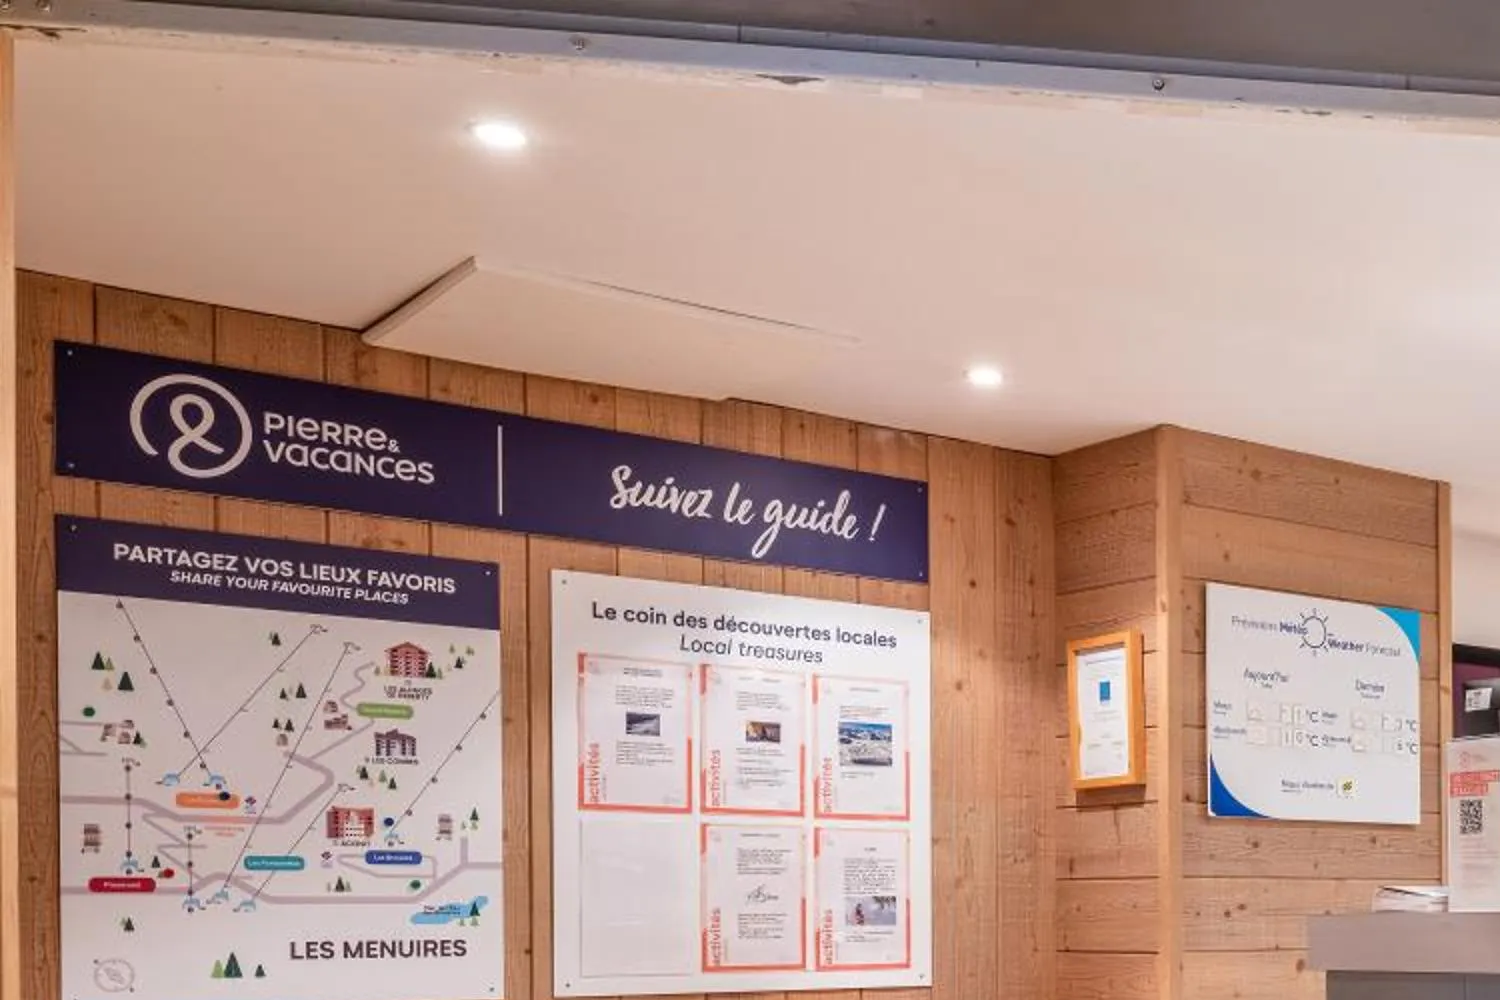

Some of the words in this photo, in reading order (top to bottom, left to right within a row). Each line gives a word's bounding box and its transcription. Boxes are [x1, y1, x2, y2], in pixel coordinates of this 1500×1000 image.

[610, 465, 713, 519] Suivez
[723, 482, 753, 525] le
[752, 490, 860, 558] guide
[113, 543, 239, 573] PARTAGEZ
[244, 556, 294, 577] VOS
[300, 563, 363, 585] LIEUX
[366, 569, 456, 594] FAVORIS
[170, 570, 222, 587] SHARE
[225, 577, 268, 592] YOUR
[271, 580, 351, 600] FAVOURITE
[354, 588, 410, 605] PLACES
[592, 601, 617, 621] Le
[623, 607, 667, 626] coin
[673, 610, 708, 630] des
[713, 614, 831, 642] découvertes
[836, 627, 898, 648] locales
[680, 634, 732, 656] Local
[738, 641, 824, 664] treasures
[290, 941, 335, 960] LES
[343, 939, 468, 959] MENUIRES
